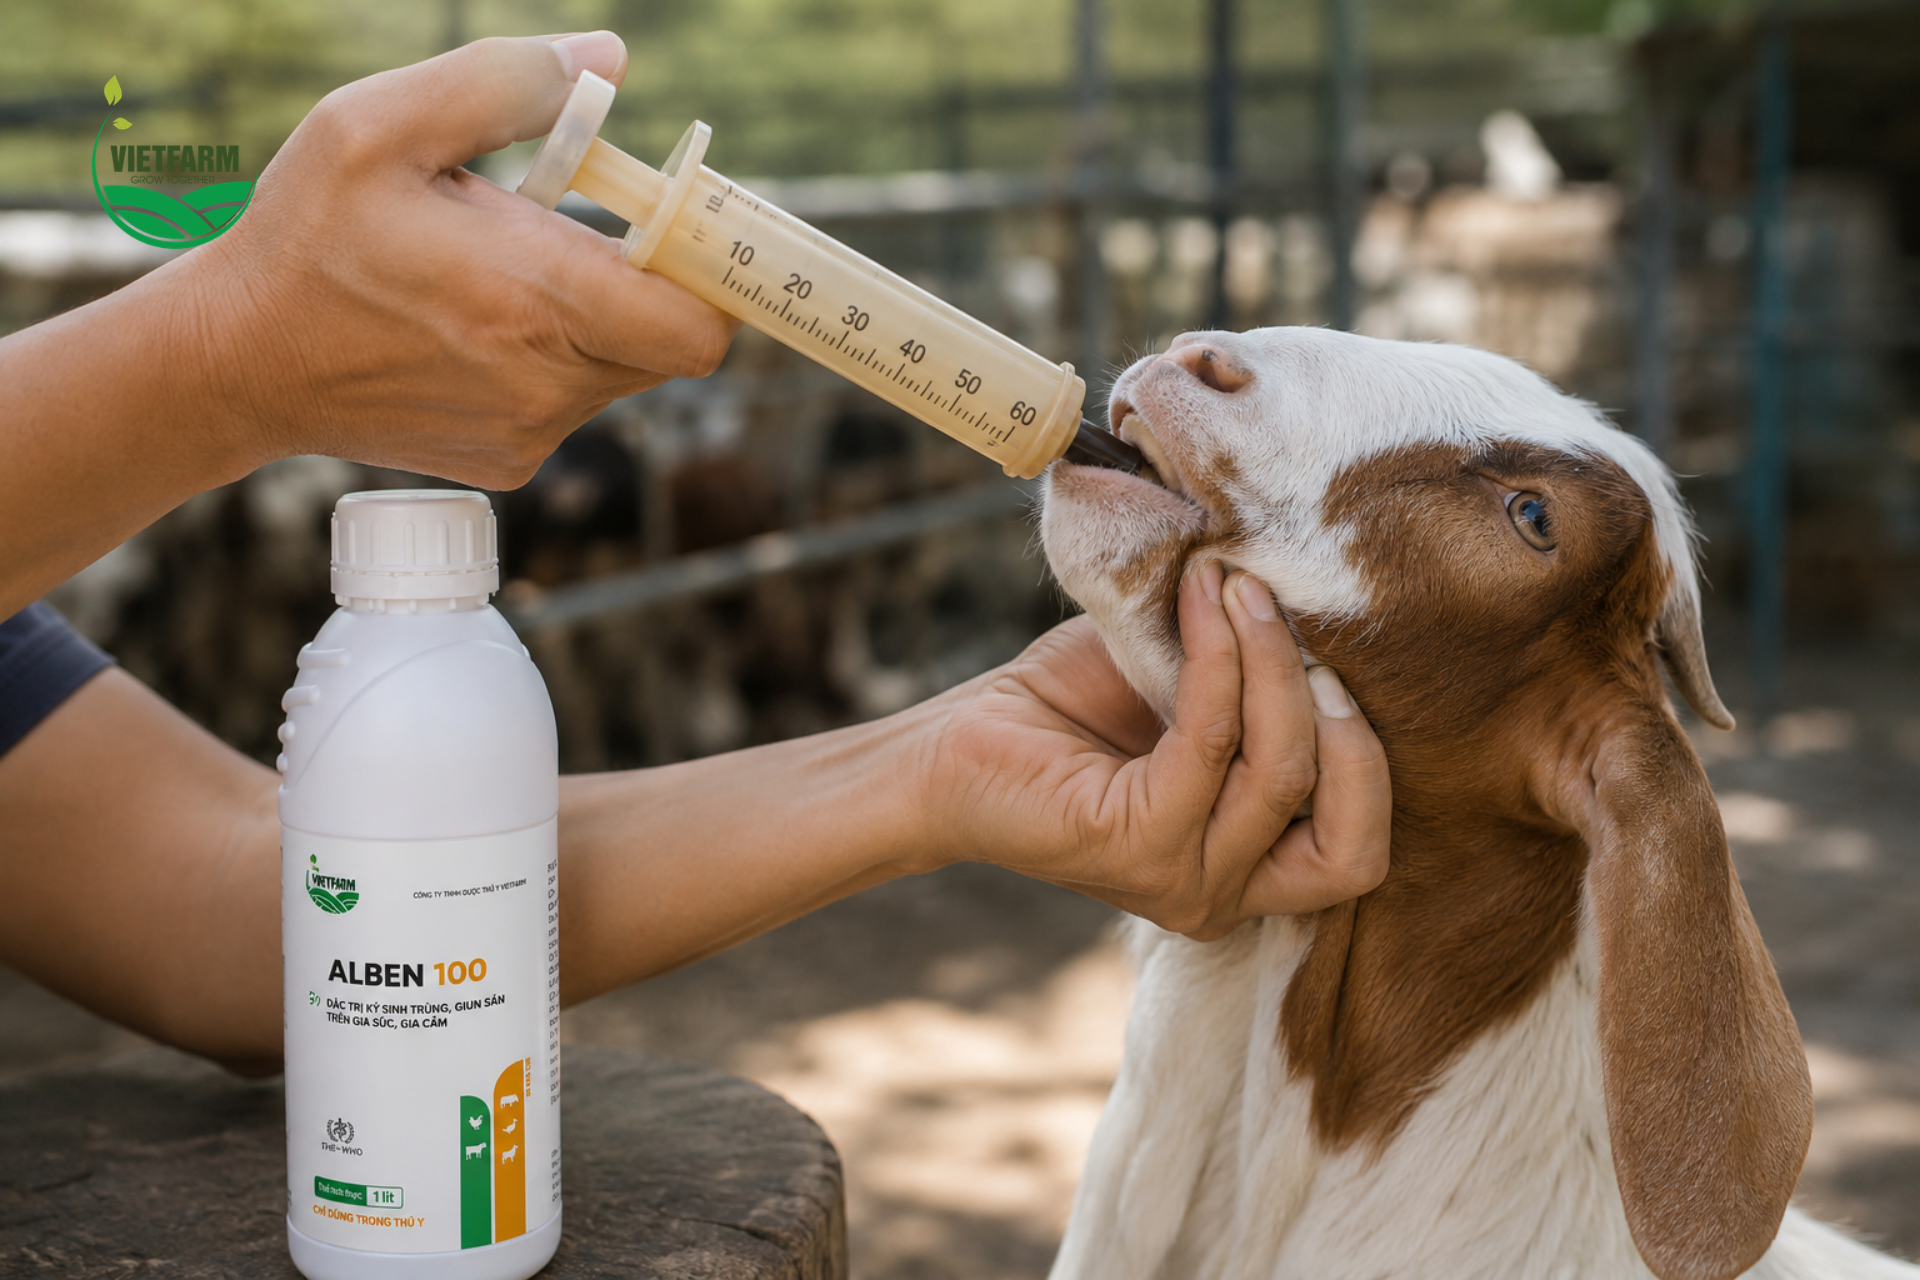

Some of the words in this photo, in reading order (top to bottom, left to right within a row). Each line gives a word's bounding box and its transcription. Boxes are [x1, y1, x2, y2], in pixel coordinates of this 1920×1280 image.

[730, 241, 755, 266] 10
[783, 273, 812, 299] 20
[841, 305, 870, 331] 30
[899, 339, 926, 364] 40
[955, 368, 982, 395] 50
[1010, 400, 1037, 426] 60
[328, 959, 424, 987] ALBEN
[433, 958, 487, 986] 100
[382, 1004, 408, 1014] SINH
[454, 999, 482, 1012] GIUN
[352, 1016, 370, 1027] GIA
[400, 1018, 420, 1029] GIA
[373, 1191, 379, 1203] 1
[356, 1214, 392, 1227] TRONG
[417, 1217, 425, 1228] Y
